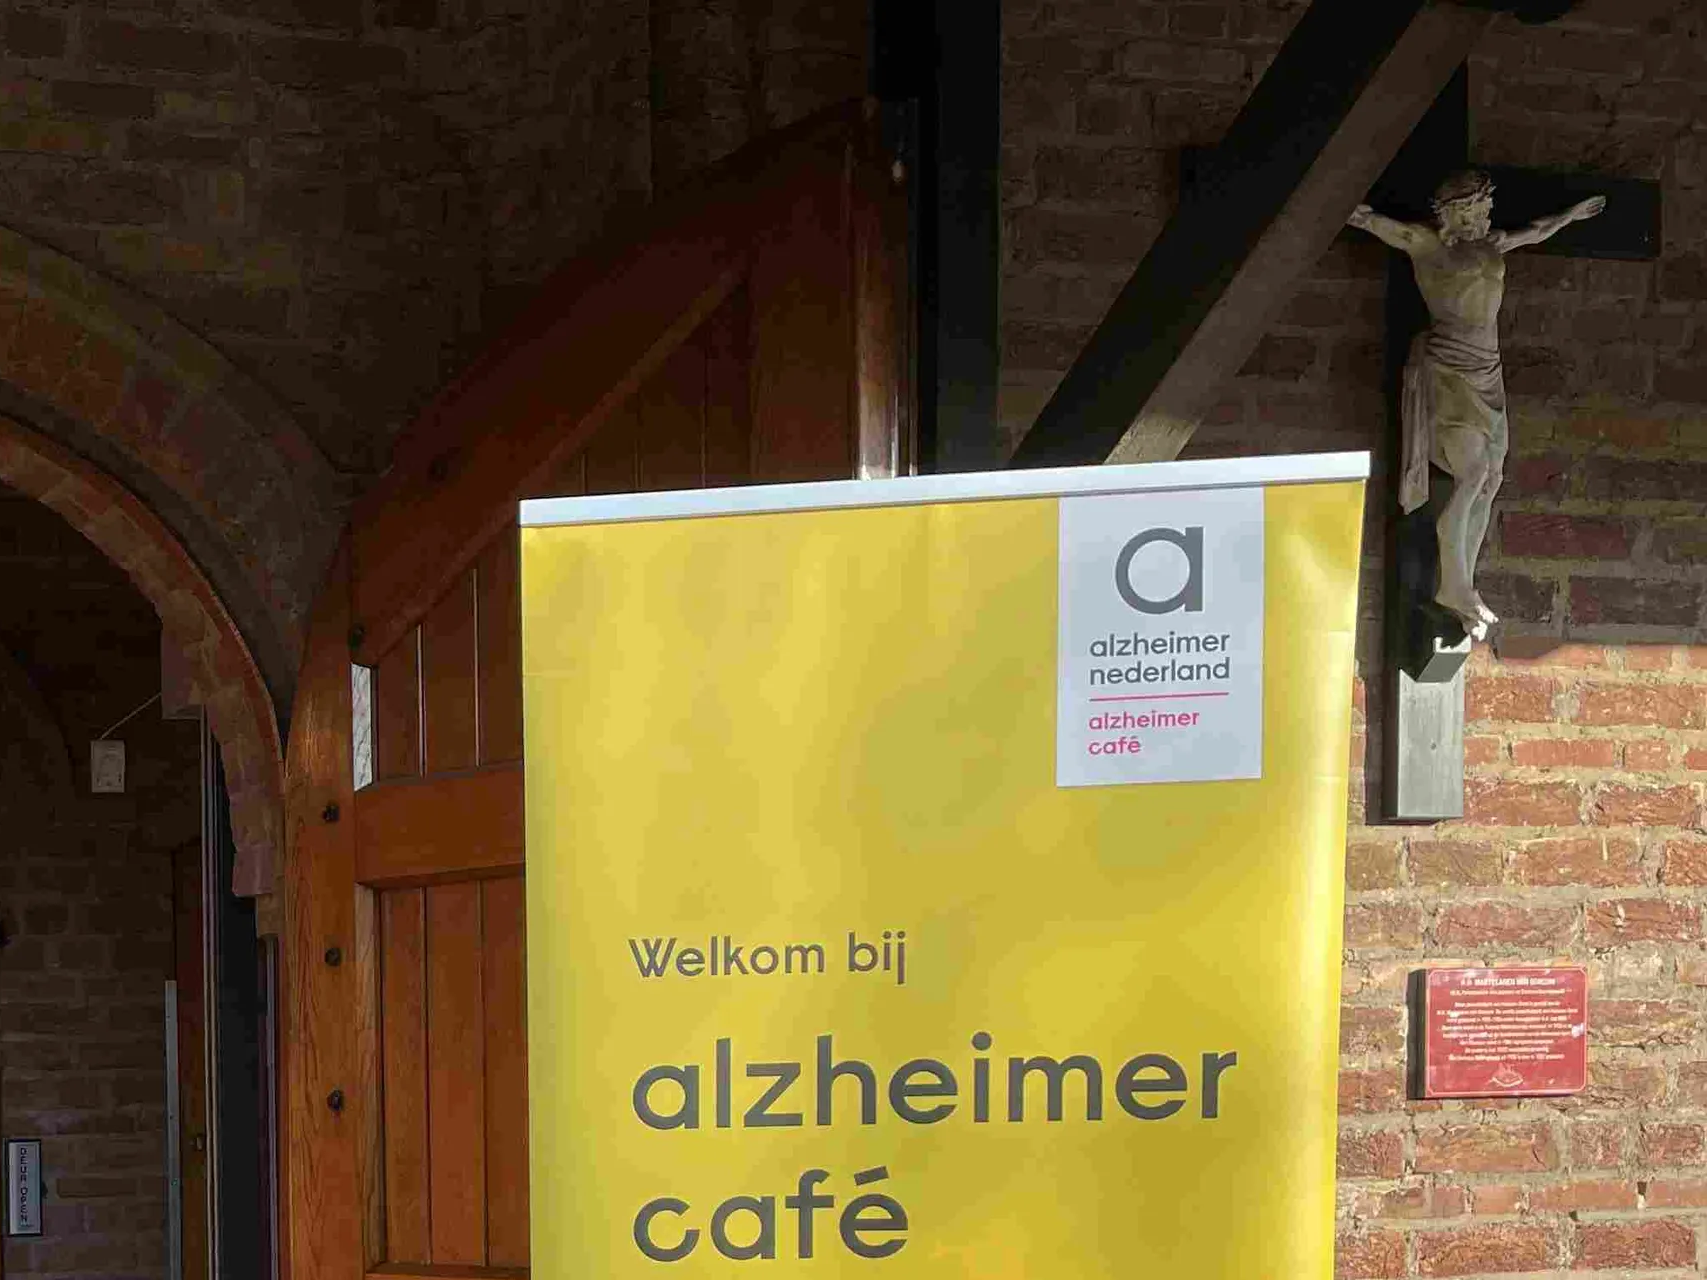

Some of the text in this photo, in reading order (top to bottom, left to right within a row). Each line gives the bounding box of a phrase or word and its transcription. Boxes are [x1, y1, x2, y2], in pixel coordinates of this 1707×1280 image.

[1089, 631, 1230, 657] alzheimer
[1089, 657, 1230, 685] nederland
[1088, 710, 1200, 731] alzheimer
[1088, 736, 1141, 756] café
[629, 931, 906, 985] Welkom bij
[632, 1031, 1237, 1131] alzheimer
[633, 1166, 909, 1263] café
